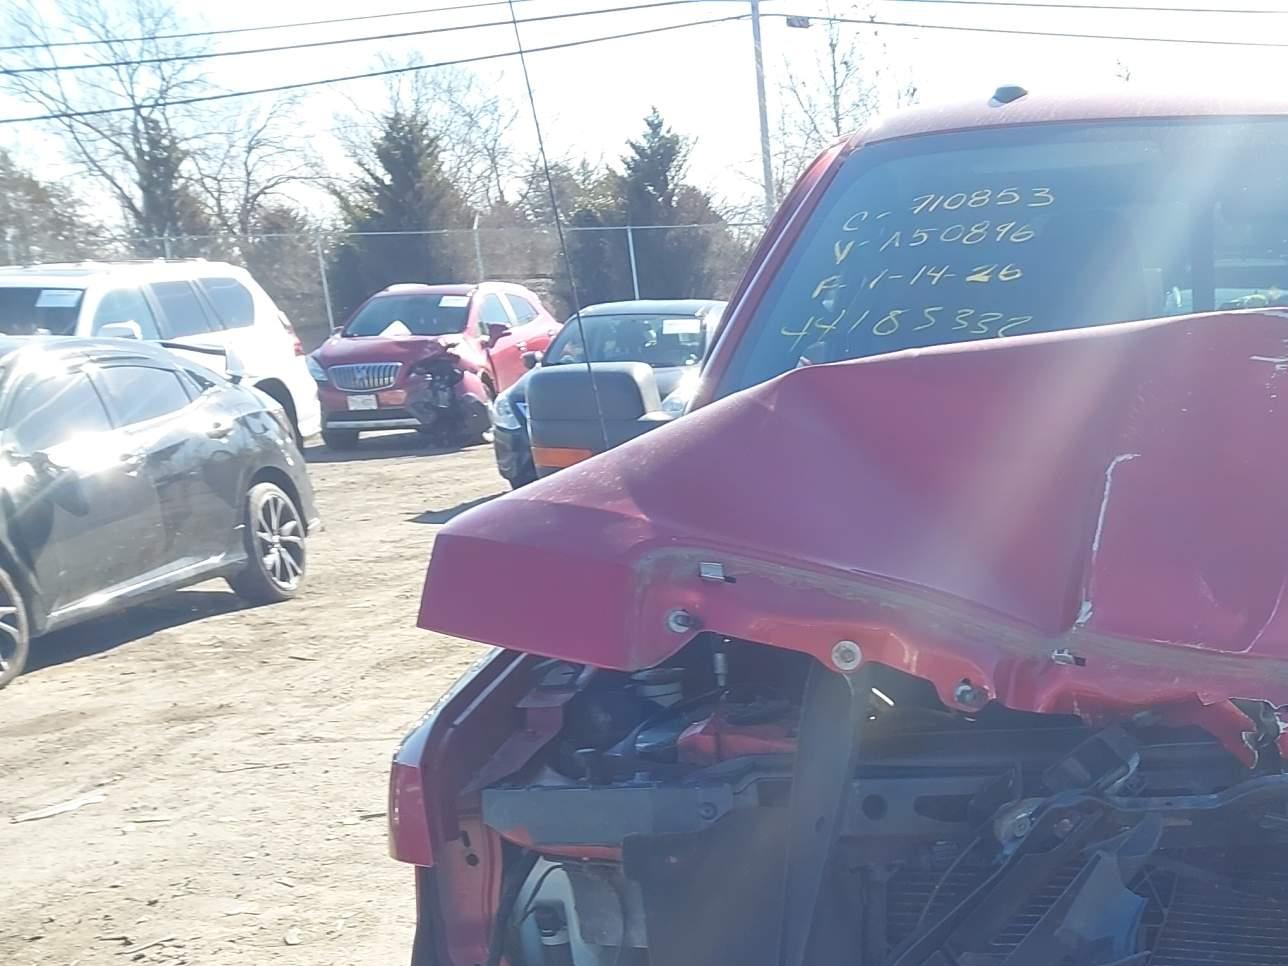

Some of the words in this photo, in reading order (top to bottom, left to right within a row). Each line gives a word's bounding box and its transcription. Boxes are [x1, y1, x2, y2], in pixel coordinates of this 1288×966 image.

[911, 187, 1054, 214] 710853
[869, 263, 1023, 289] 1-14-26
[781, 307, 1033, 352] 44185332
